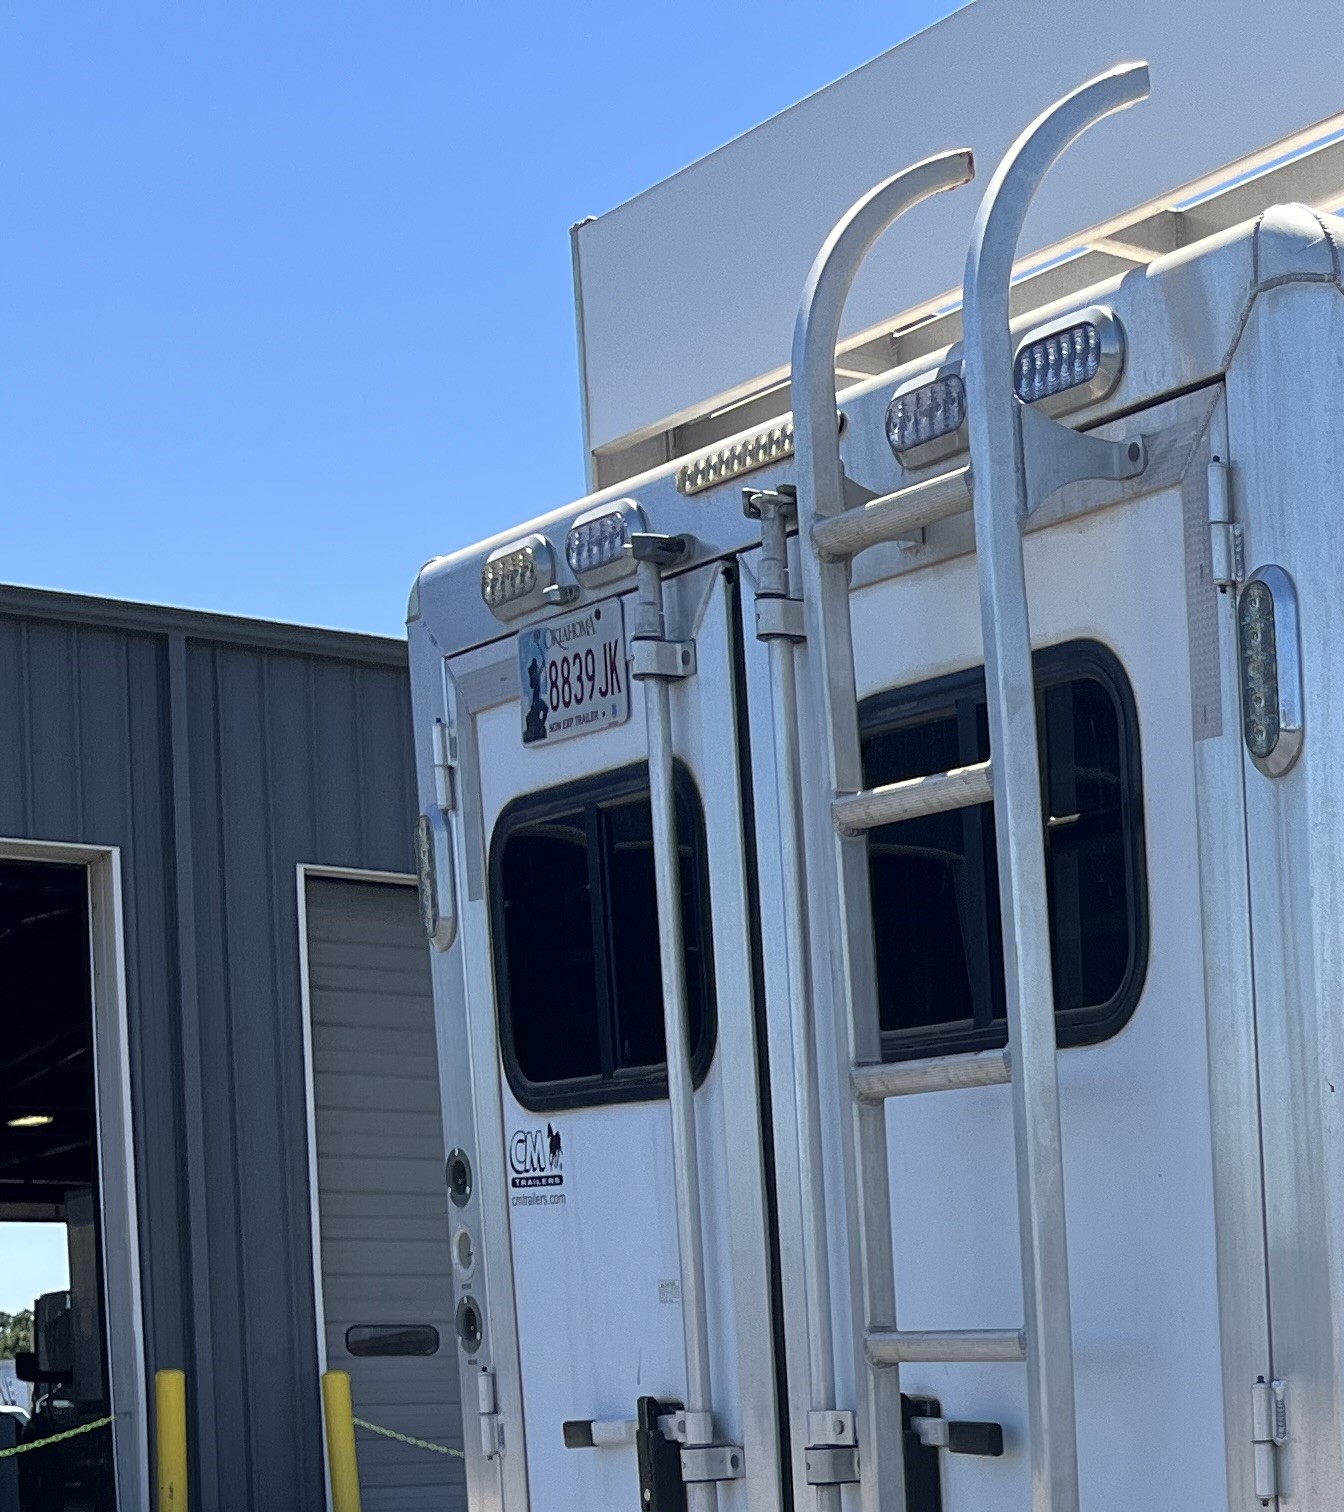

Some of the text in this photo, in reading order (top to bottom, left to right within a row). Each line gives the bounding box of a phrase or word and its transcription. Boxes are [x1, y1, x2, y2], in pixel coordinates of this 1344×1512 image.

[543, 613, 597, 651] OKLAHOMA
[575, 710, 599, 725] TRAILER
[509, 1130, 546, 1174] CM
[515, 1177, 560, 1187] TRAILERS
[512, 1193, 567, 1207] cmtrailers.com
